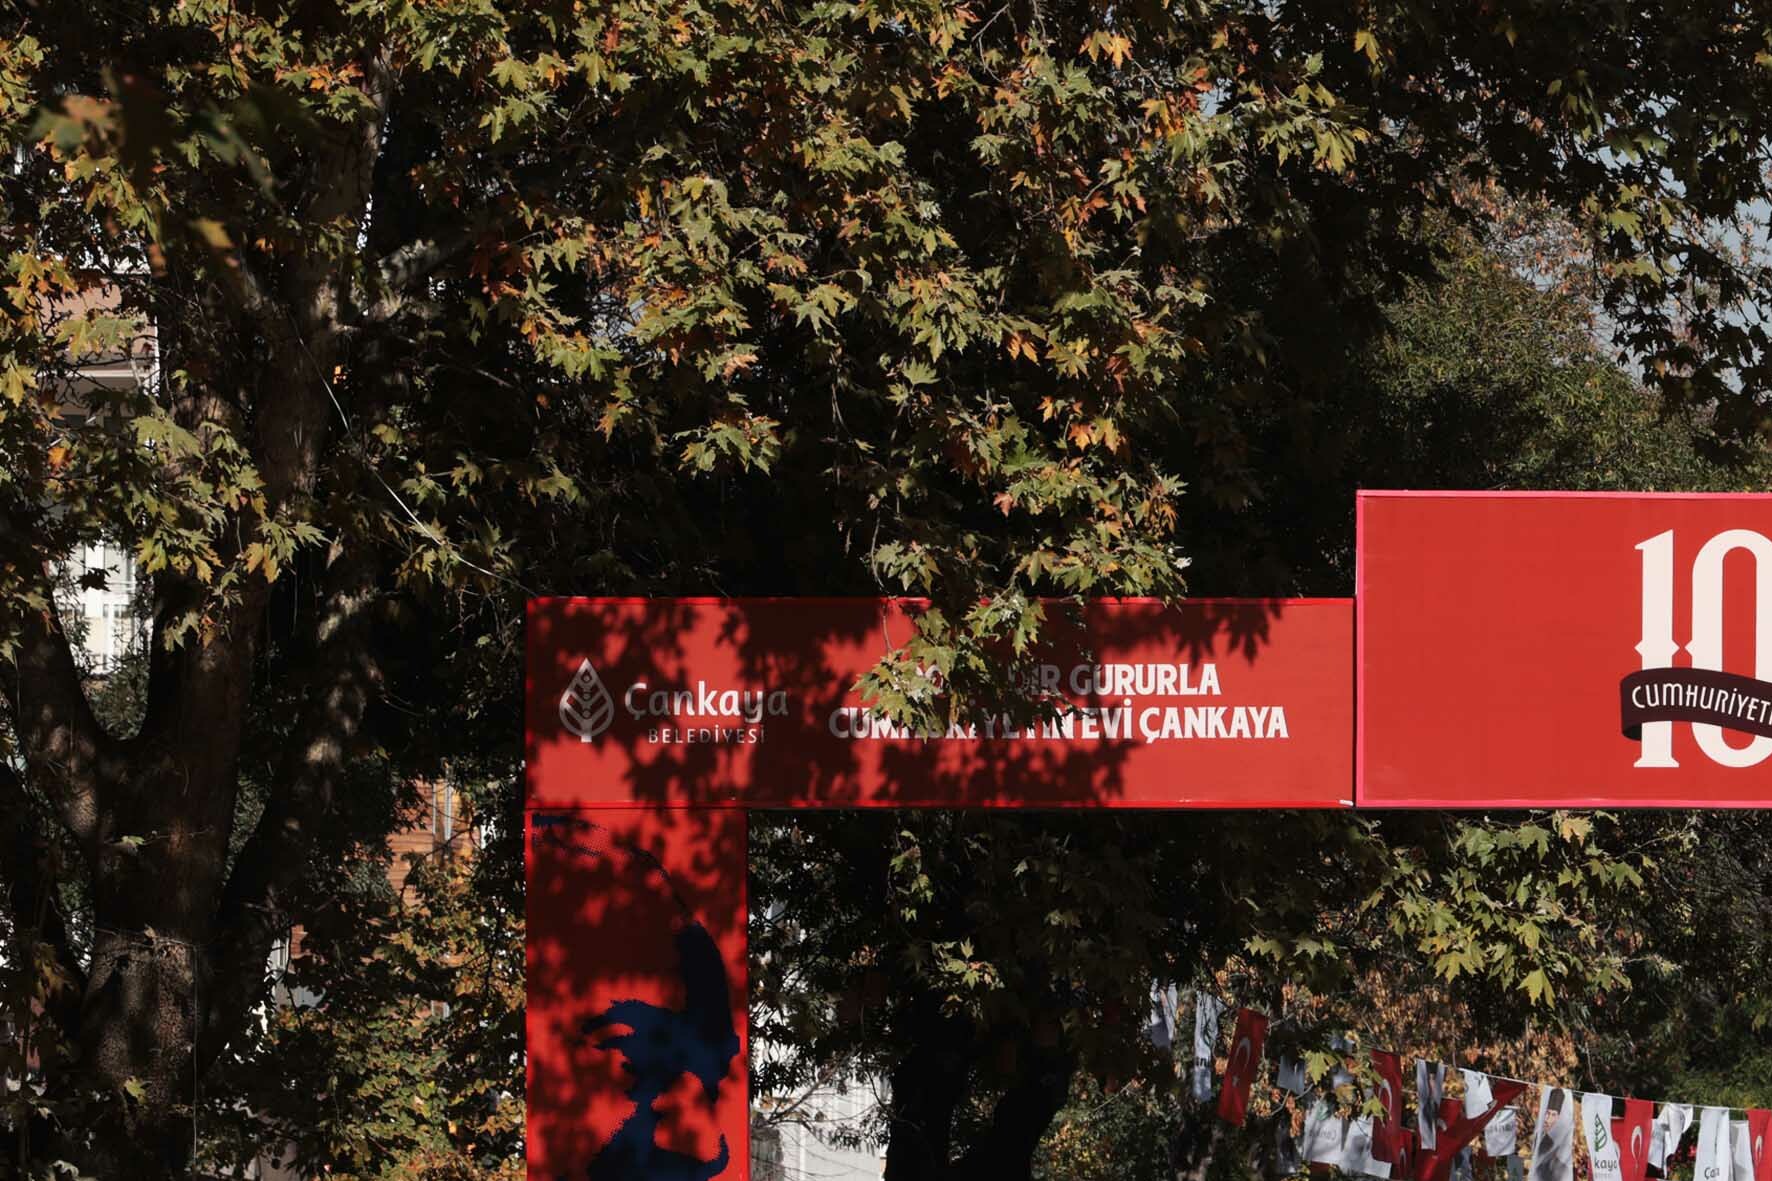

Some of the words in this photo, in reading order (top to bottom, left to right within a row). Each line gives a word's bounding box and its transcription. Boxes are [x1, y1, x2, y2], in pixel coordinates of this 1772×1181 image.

[1069, 663, 1222, 696] GURURLA
[624, 681, 789, 723] Çankaya
[648, 724, 766, 744] BELEDİYESİ
[1139, 706, 1289, 744] ÇANKAYA
